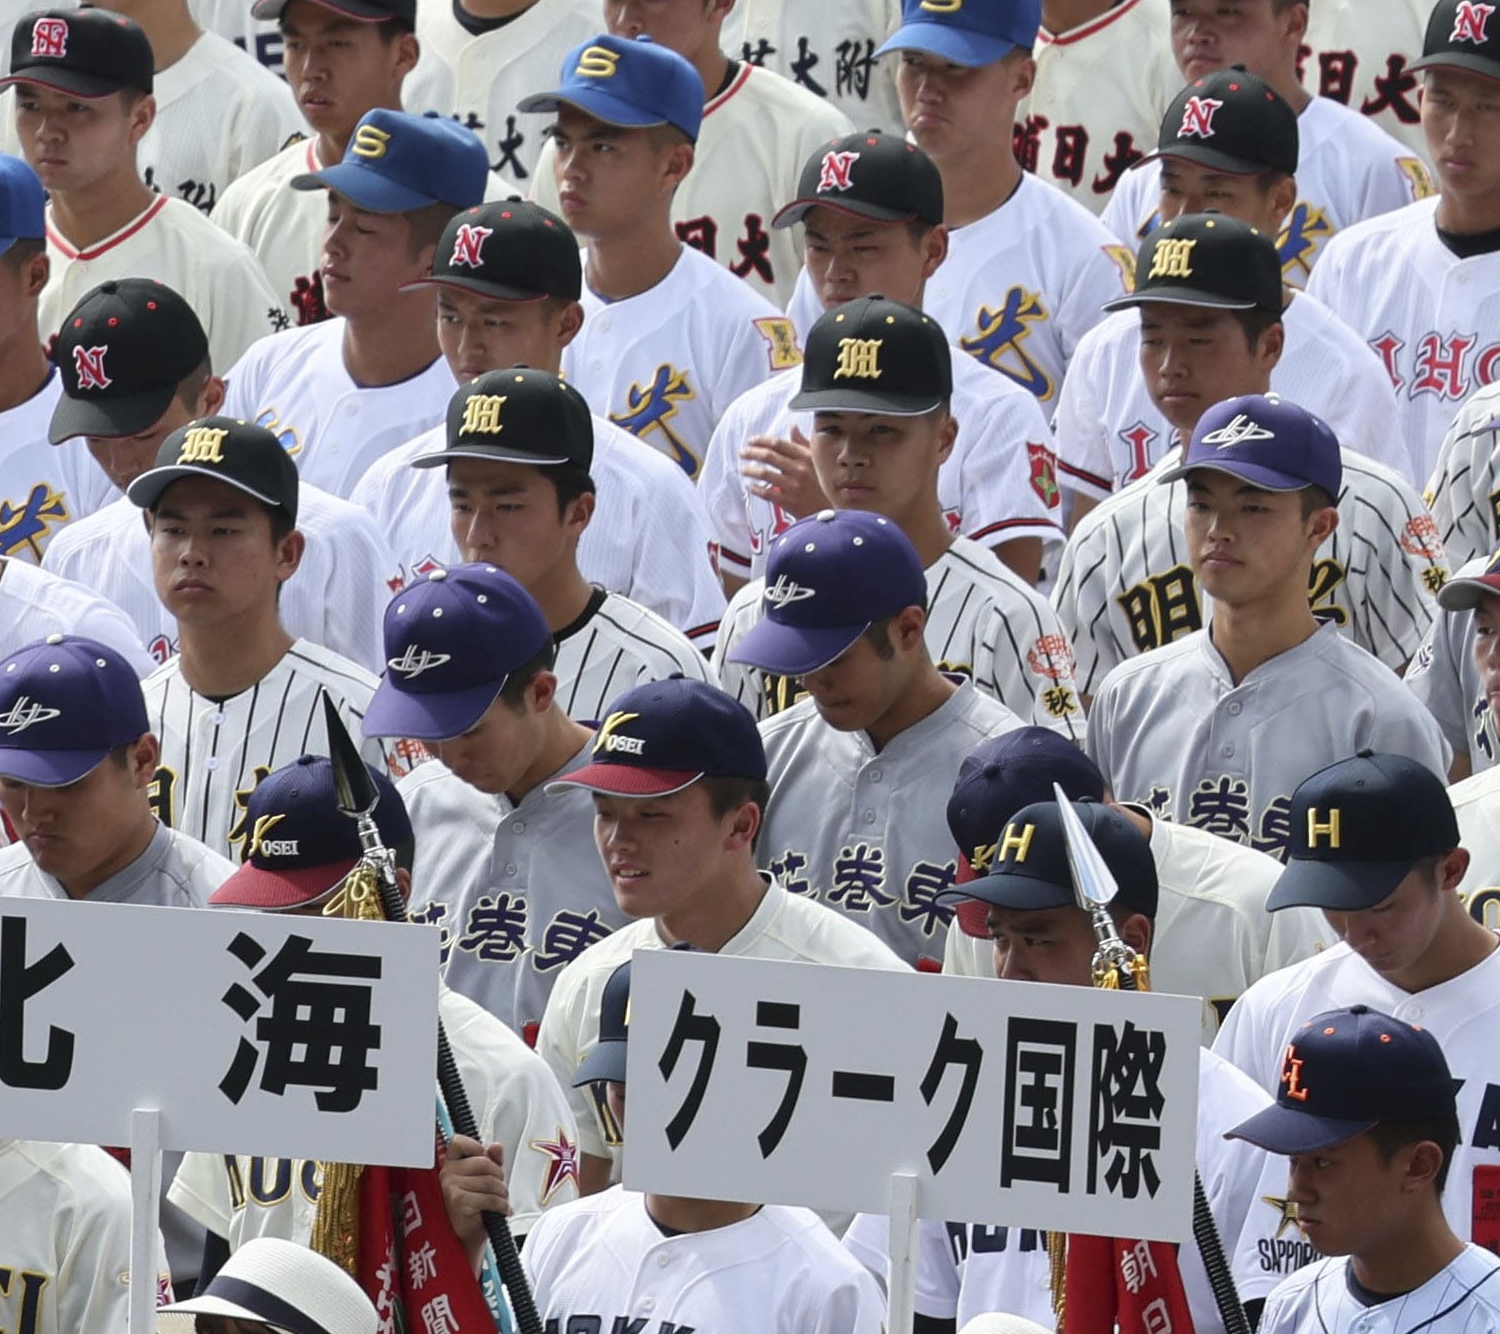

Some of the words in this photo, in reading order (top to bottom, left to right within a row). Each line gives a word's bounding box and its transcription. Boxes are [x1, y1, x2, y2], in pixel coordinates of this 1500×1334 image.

[1296, 45, 1422, 125] 日大
[1177, 95, 1224, 140] N
[817, 150, 860, 194] N
[72, 343, 111, 390] N
[1041, 684, 1078, 718] 秋
[999, 822, 1037, 864] H
[1307, 807, 1341, 850] H
[658, 988, 1167, 1200] クラーク国際
